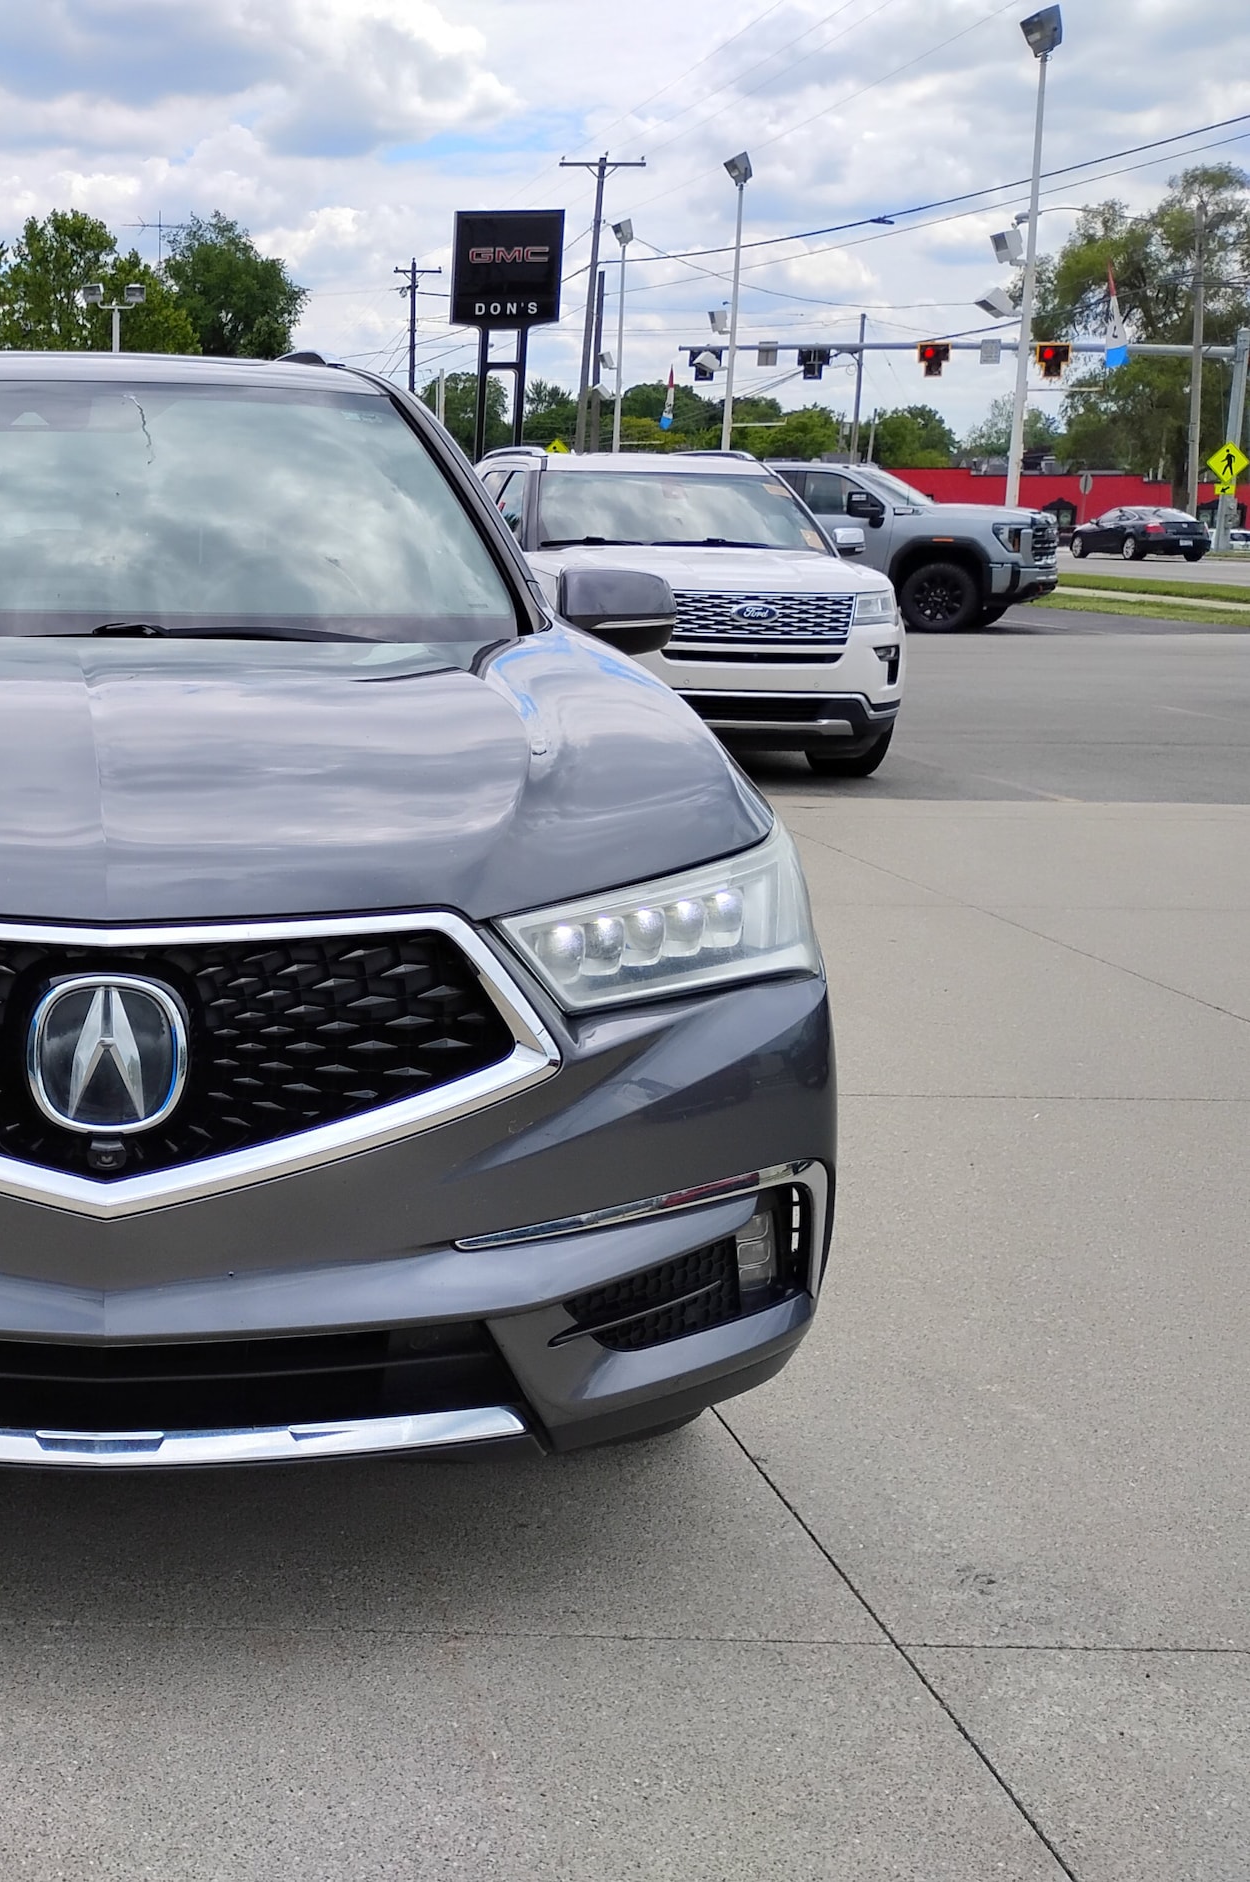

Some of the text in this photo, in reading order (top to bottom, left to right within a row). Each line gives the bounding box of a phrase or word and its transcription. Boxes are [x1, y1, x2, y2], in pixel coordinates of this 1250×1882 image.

[469, 246, 550, 264] GMC
[474, 301, 538, 316] DON'S
[743, 606, 770, 618] Ford
